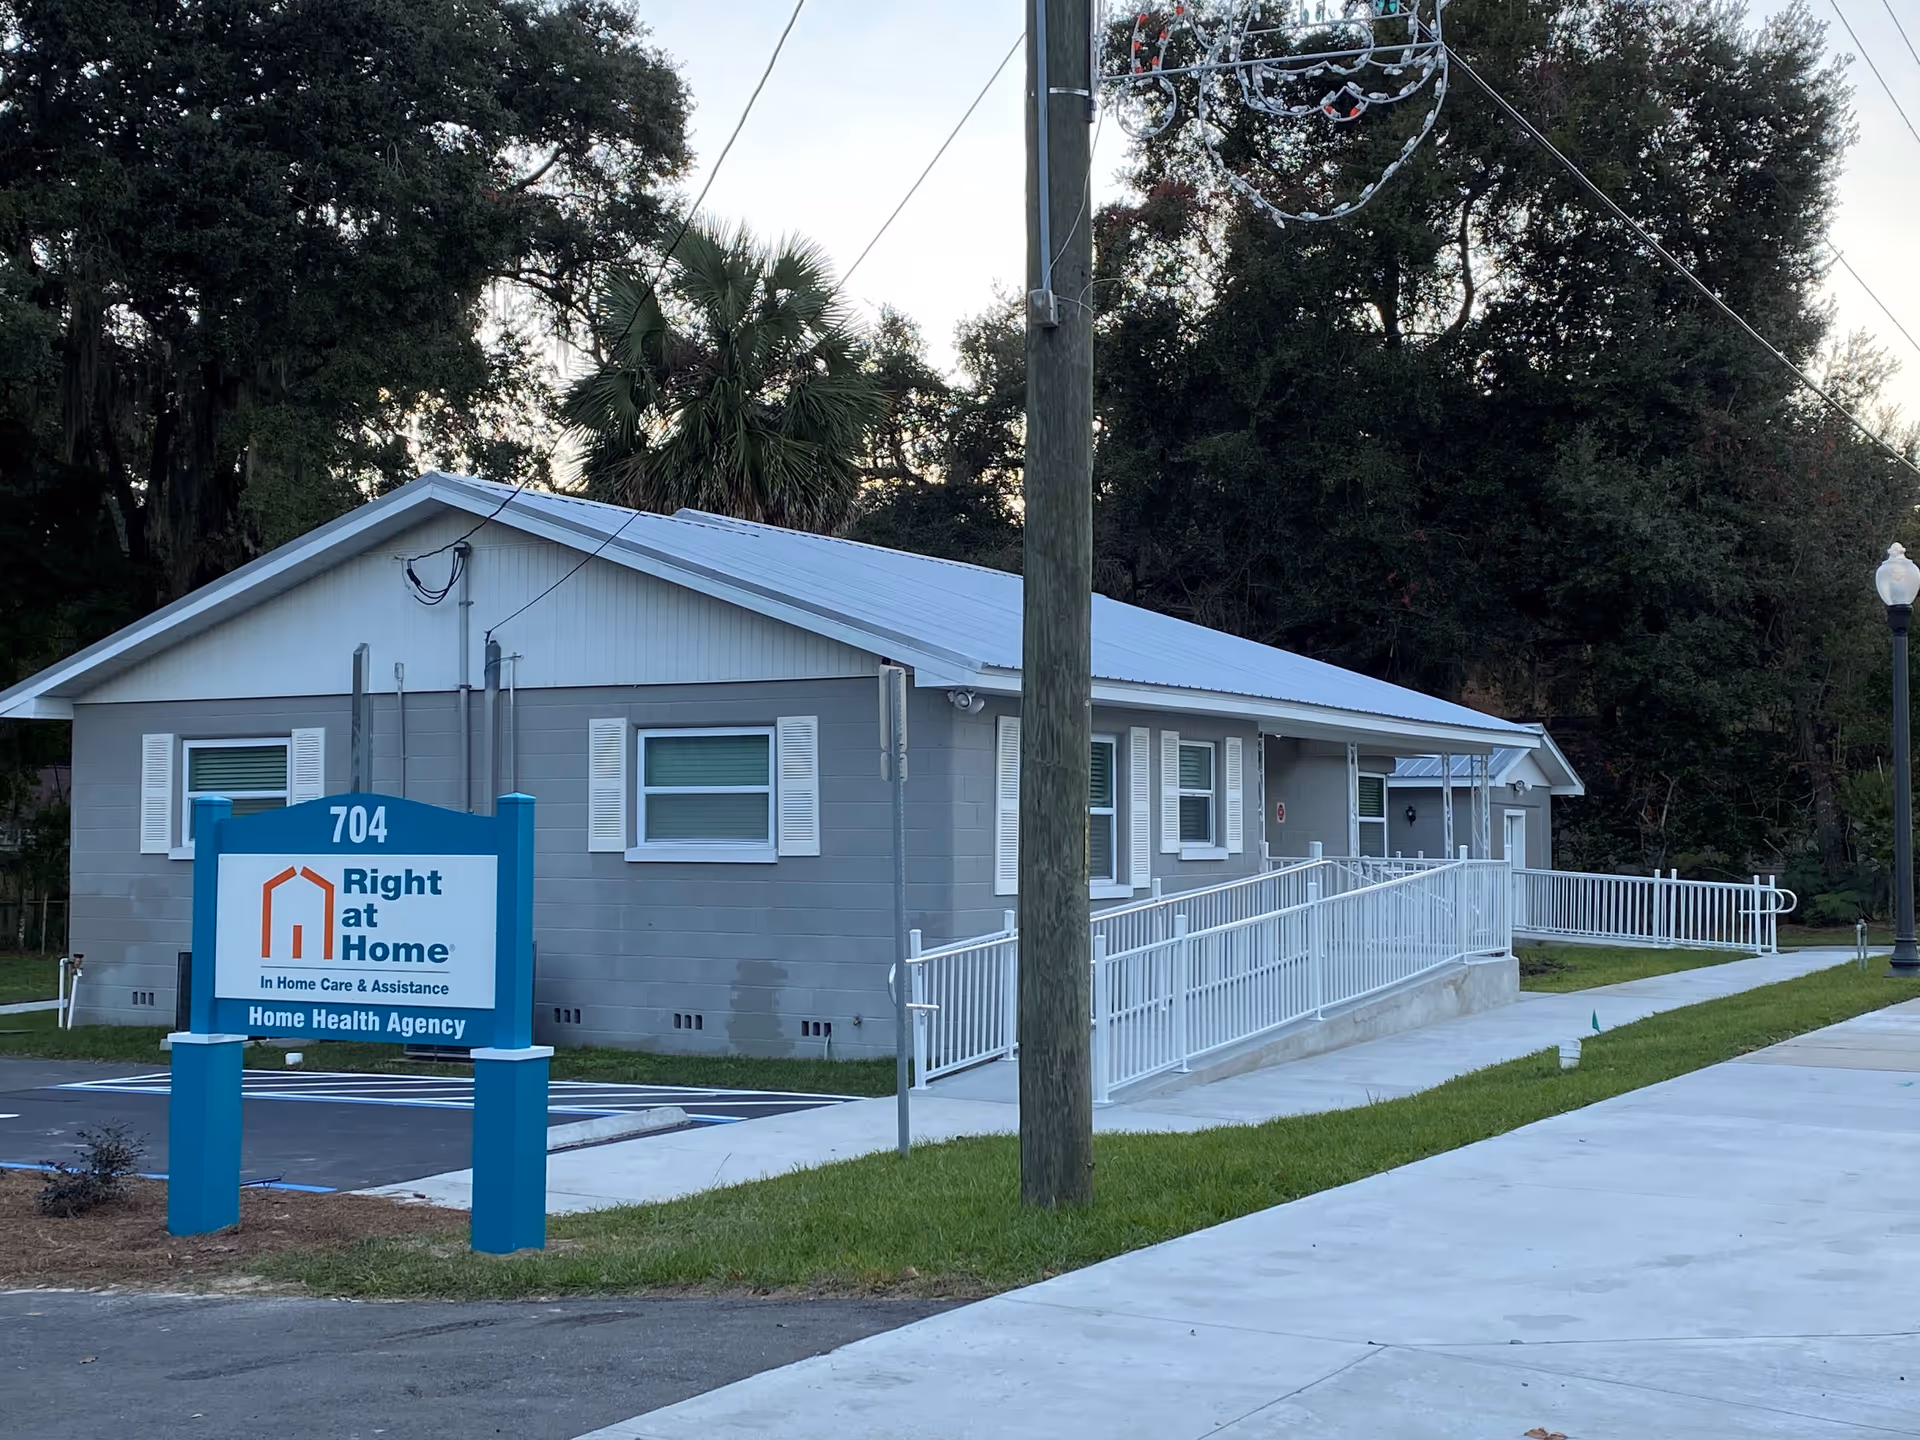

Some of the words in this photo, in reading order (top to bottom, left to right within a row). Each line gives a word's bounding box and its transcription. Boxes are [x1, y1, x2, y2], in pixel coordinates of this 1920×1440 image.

[329, 805, 387, 843] 704
[343, 868, 443, 901] Right
[341, 903, 378, 928] at
[260, 975, 273, 989] In
[277, 976, 316, 991] Home
[320, 978, 353, 992] Care
[357, 979, 367, 993] &
[371, 980, 449, 995] Assistance
[249, 1006, 305, 1028] Home
[312, 1008, 380, 1032] Health
[386, 1012, 466, 1039] Agency
